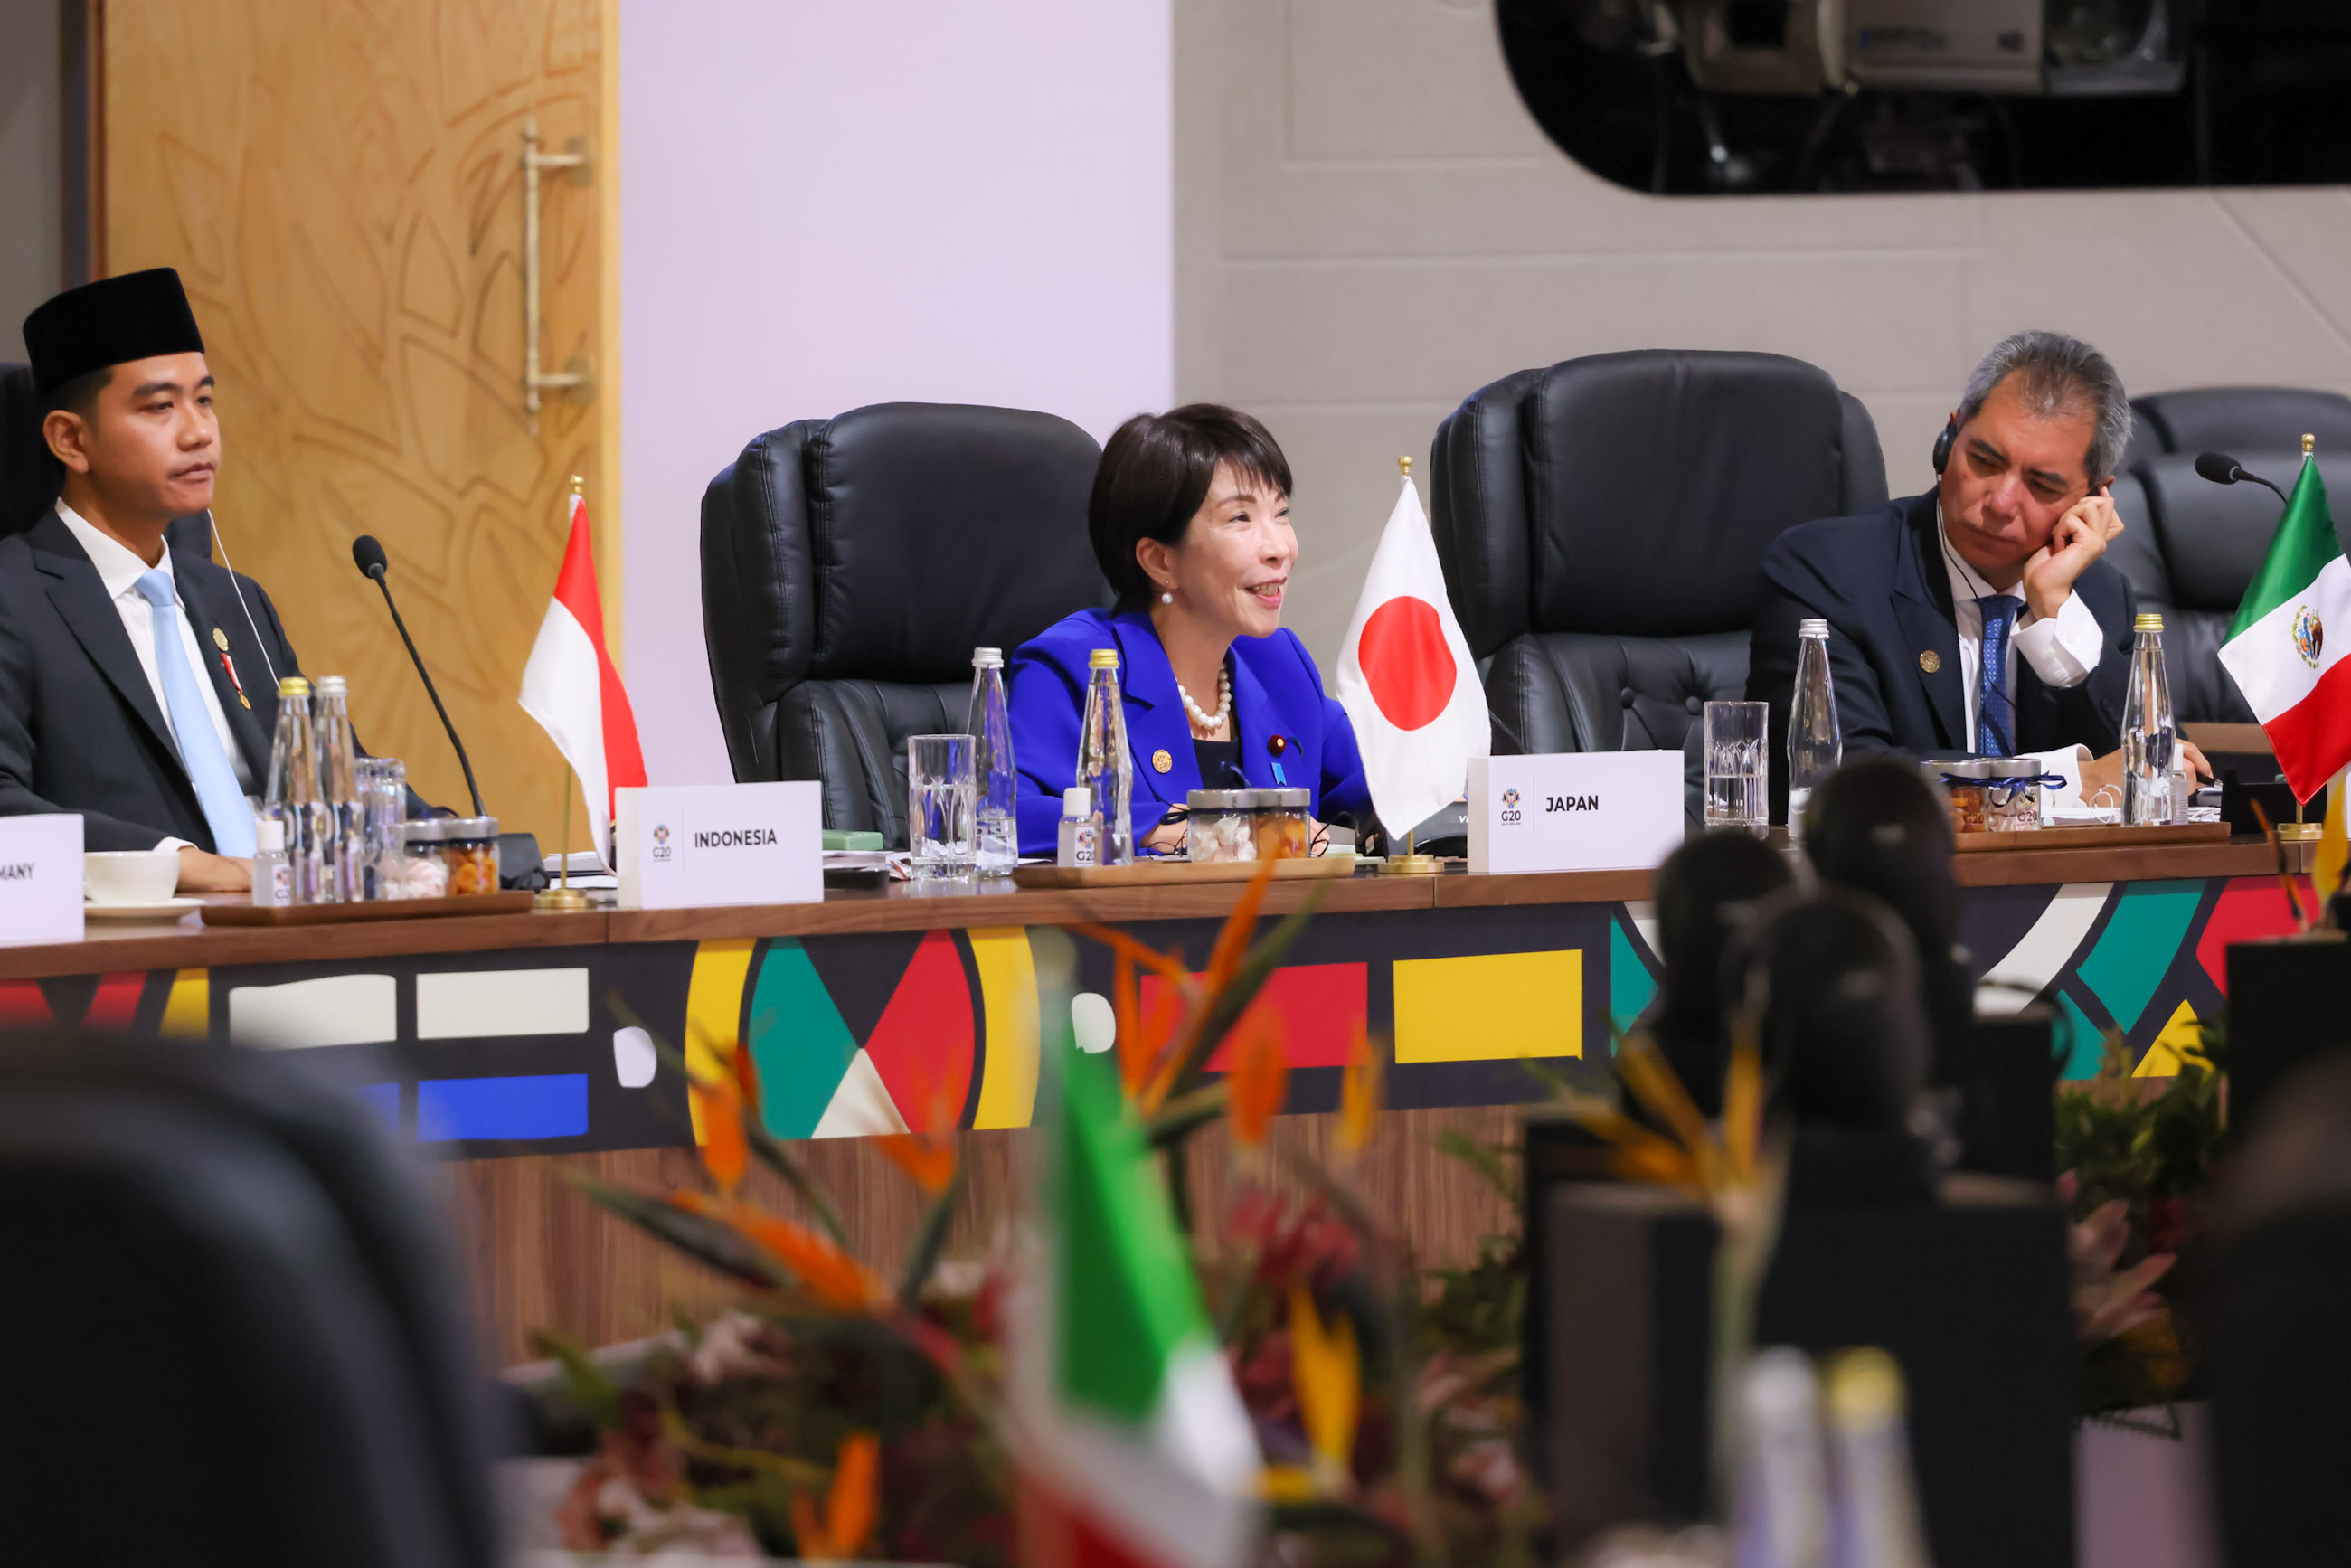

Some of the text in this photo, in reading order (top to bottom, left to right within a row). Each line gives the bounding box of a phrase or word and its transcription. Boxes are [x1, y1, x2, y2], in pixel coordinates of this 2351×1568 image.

[1545, 795, 1599, 812] JAPAN
[1501, 810, 1521, 822] G20
[2017, 811, 2037, 822] G20
[694, 828, 777, 848] INDONESIA
[652, 846, 672, 858] G20
